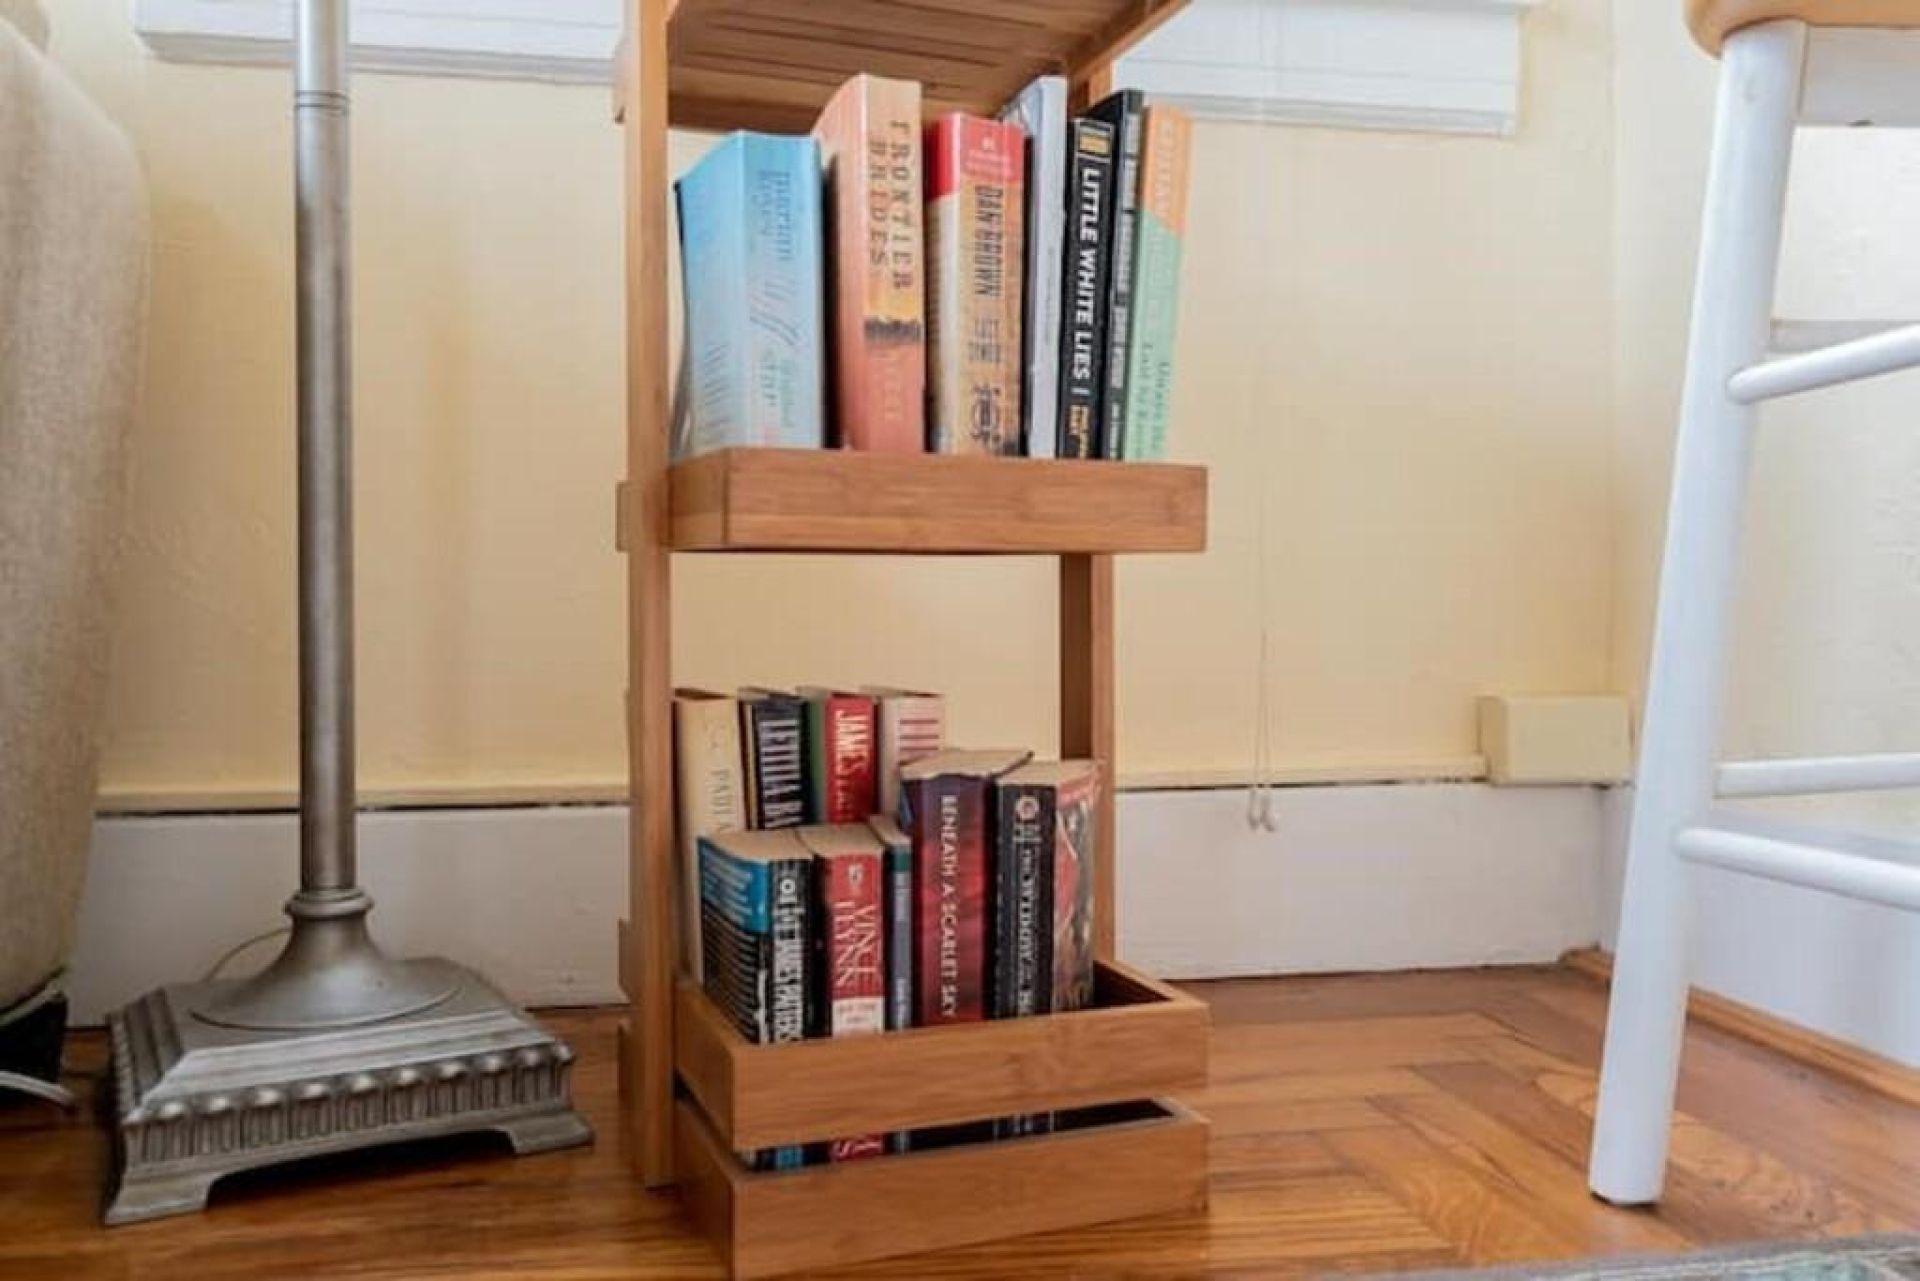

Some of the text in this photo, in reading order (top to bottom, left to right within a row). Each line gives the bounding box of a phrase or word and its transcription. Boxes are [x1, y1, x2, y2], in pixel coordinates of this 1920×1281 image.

[1078, 166, 1101, 243] LITTLE
[1075, 247, 1098, 325] WHITE
[1070, 329, 1094, 381] LIES
[938, 794, 960, 1019] BENEATH A SCARLET SKY
